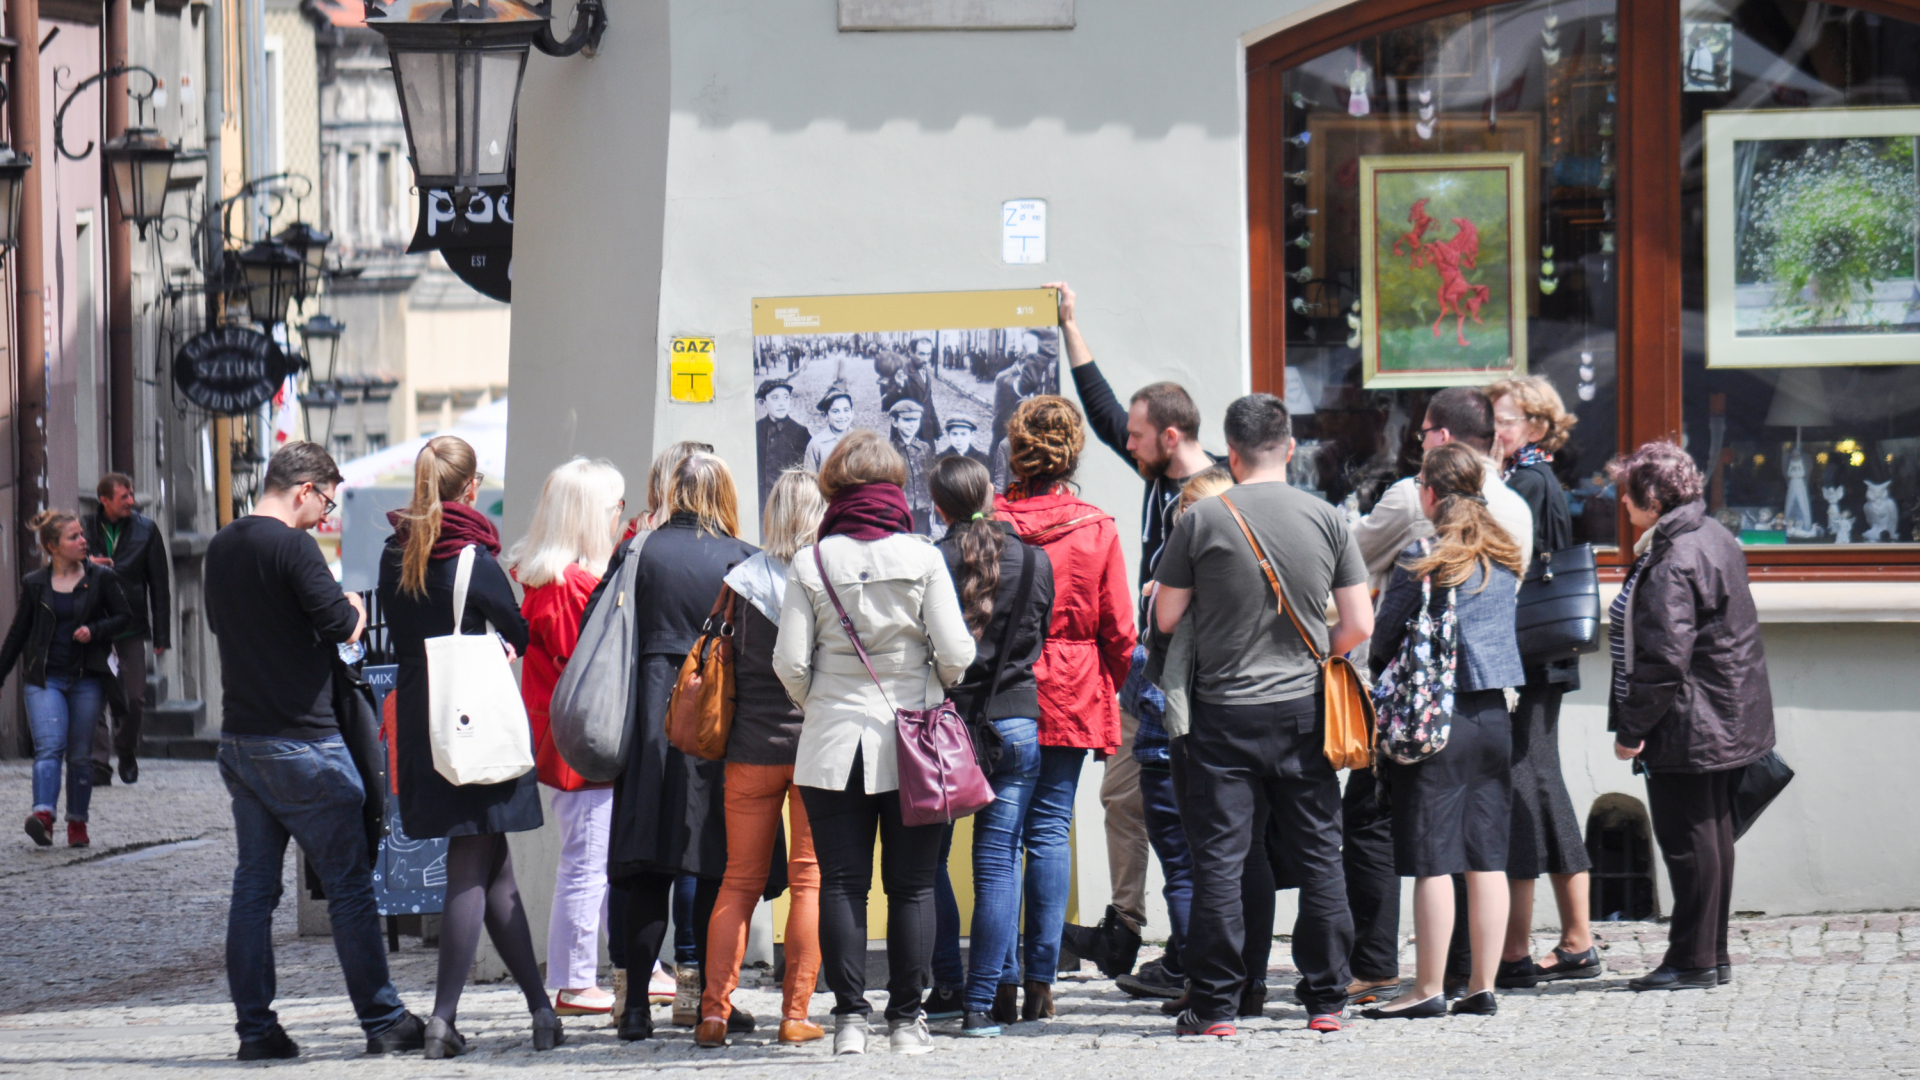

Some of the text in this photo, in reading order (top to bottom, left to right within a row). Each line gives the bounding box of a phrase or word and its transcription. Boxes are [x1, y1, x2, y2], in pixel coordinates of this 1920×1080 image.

[1005, 208, 1017, 227] Z
[471, 256, 487, 267] EST
[673, 340, 711, 353] GAZ
[198, 360, 265, 379] SZTUKI
[369, 674, 392, 685] MIX
